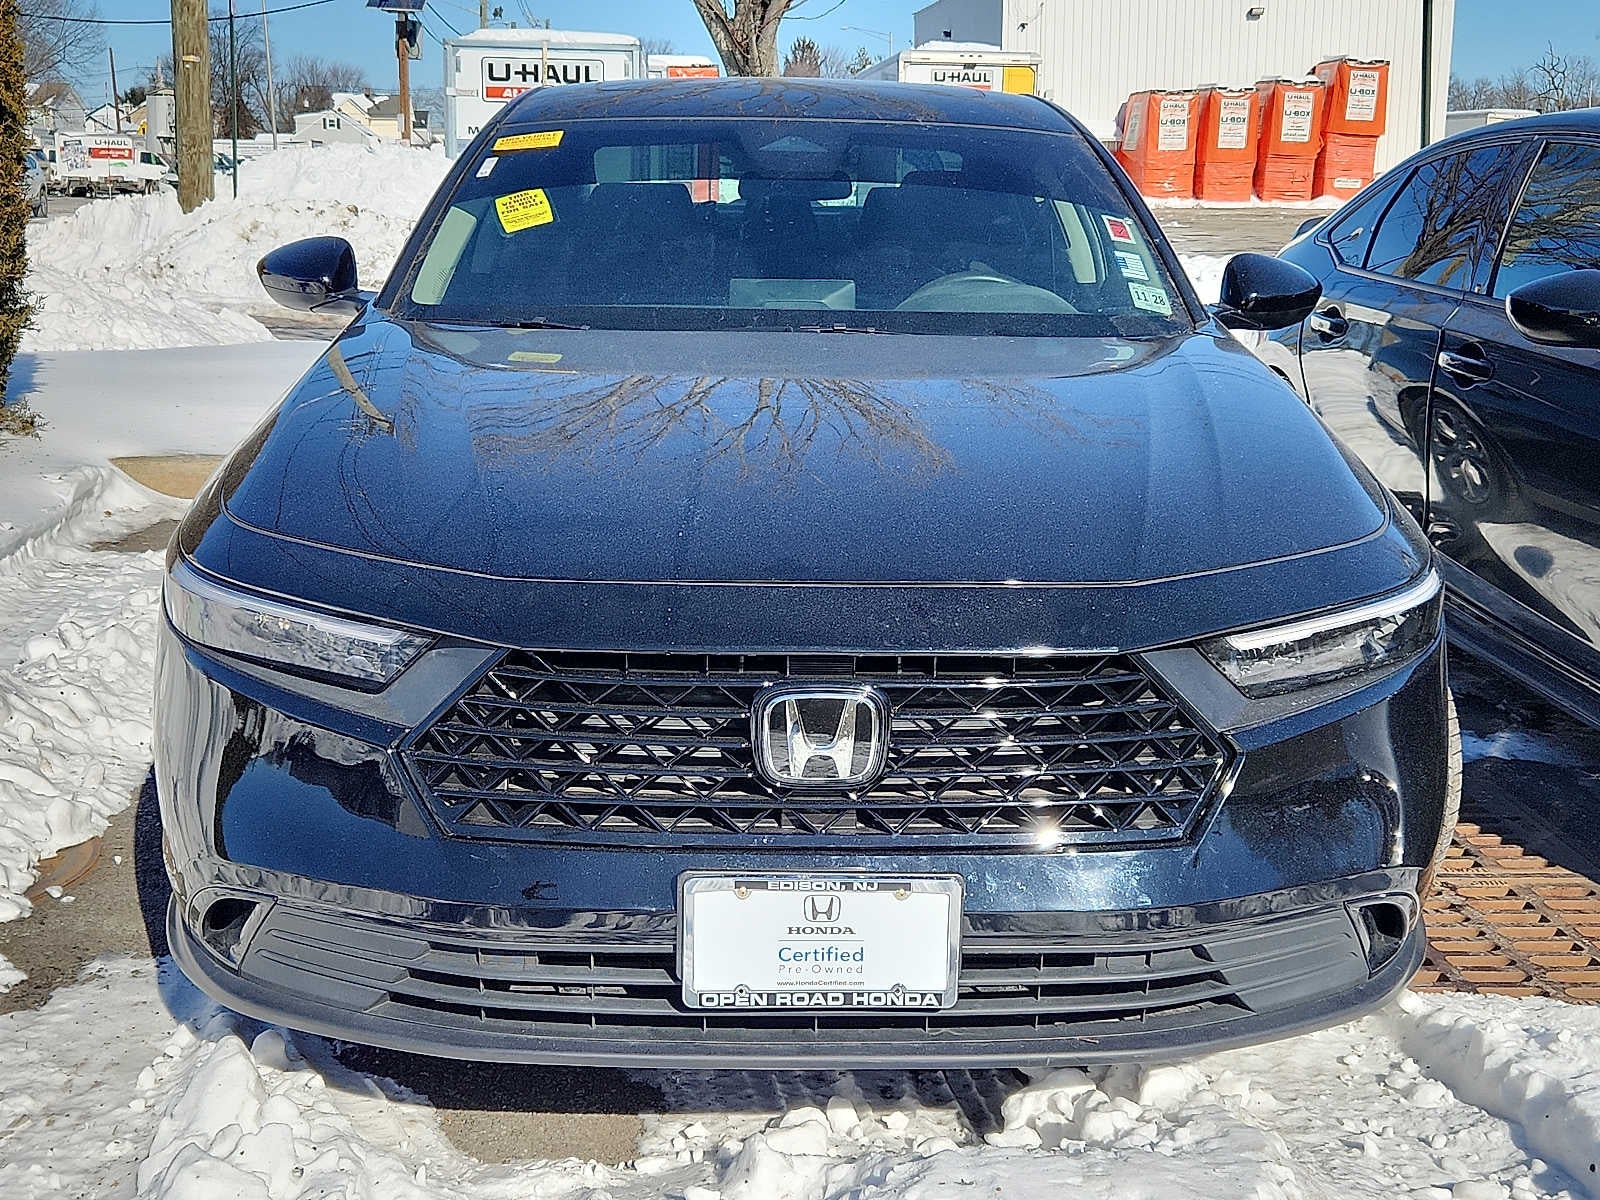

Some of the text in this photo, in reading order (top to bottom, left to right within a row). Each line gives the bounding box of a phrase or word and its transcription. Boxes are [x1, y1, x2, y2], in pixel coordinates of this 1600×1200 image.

[488, 62, 598, 84] U-HAUL
[934, 71, 991, 83] U-HAUL
[1349, 88, 1375, 96] U-BOX
[1135, 290, 1166, 306] 11 28
[853, 881, 879, 891] NJ
[787, 926, 856, 935] HONDA
[778, 946, 864, 962] Certified
[701, 992, 940, 1007] OPEN ROAD HONDA
